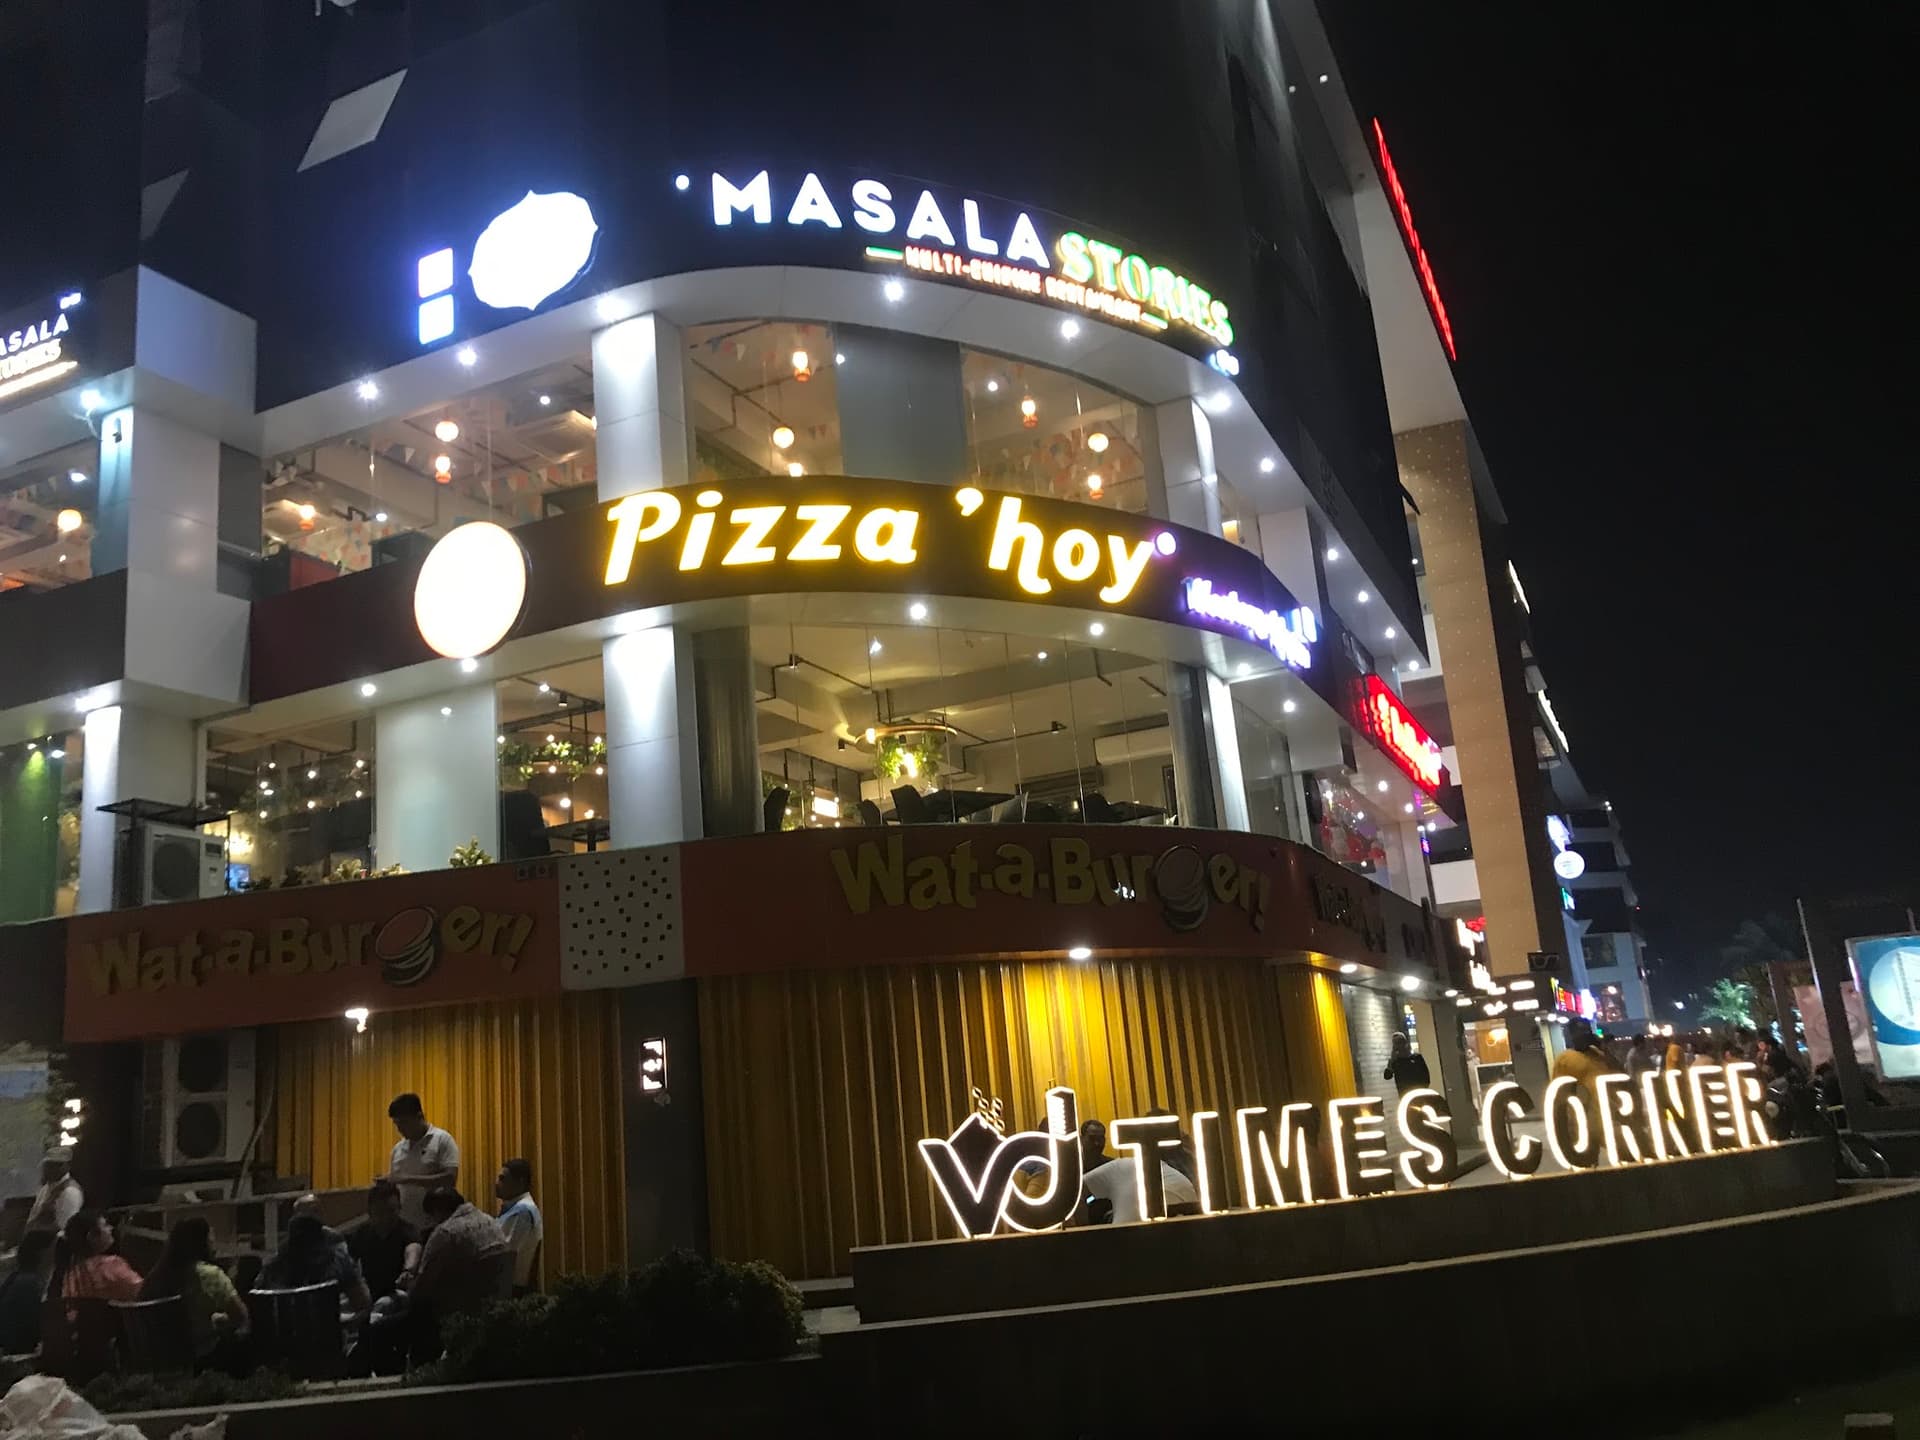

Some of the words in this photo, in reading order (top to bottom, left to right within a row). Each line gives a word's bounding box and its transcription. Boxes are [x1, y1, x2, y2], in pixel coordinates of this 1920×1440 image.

[710, 170, 1051, 268] MASALA
[1056, 230, 1234, 346] STORIES
[605, 491, 919, 586] Pizza
[1110, 1088, 1458, 1221] TIMES
[1482, 1062, 1778, 1180] CORNER
